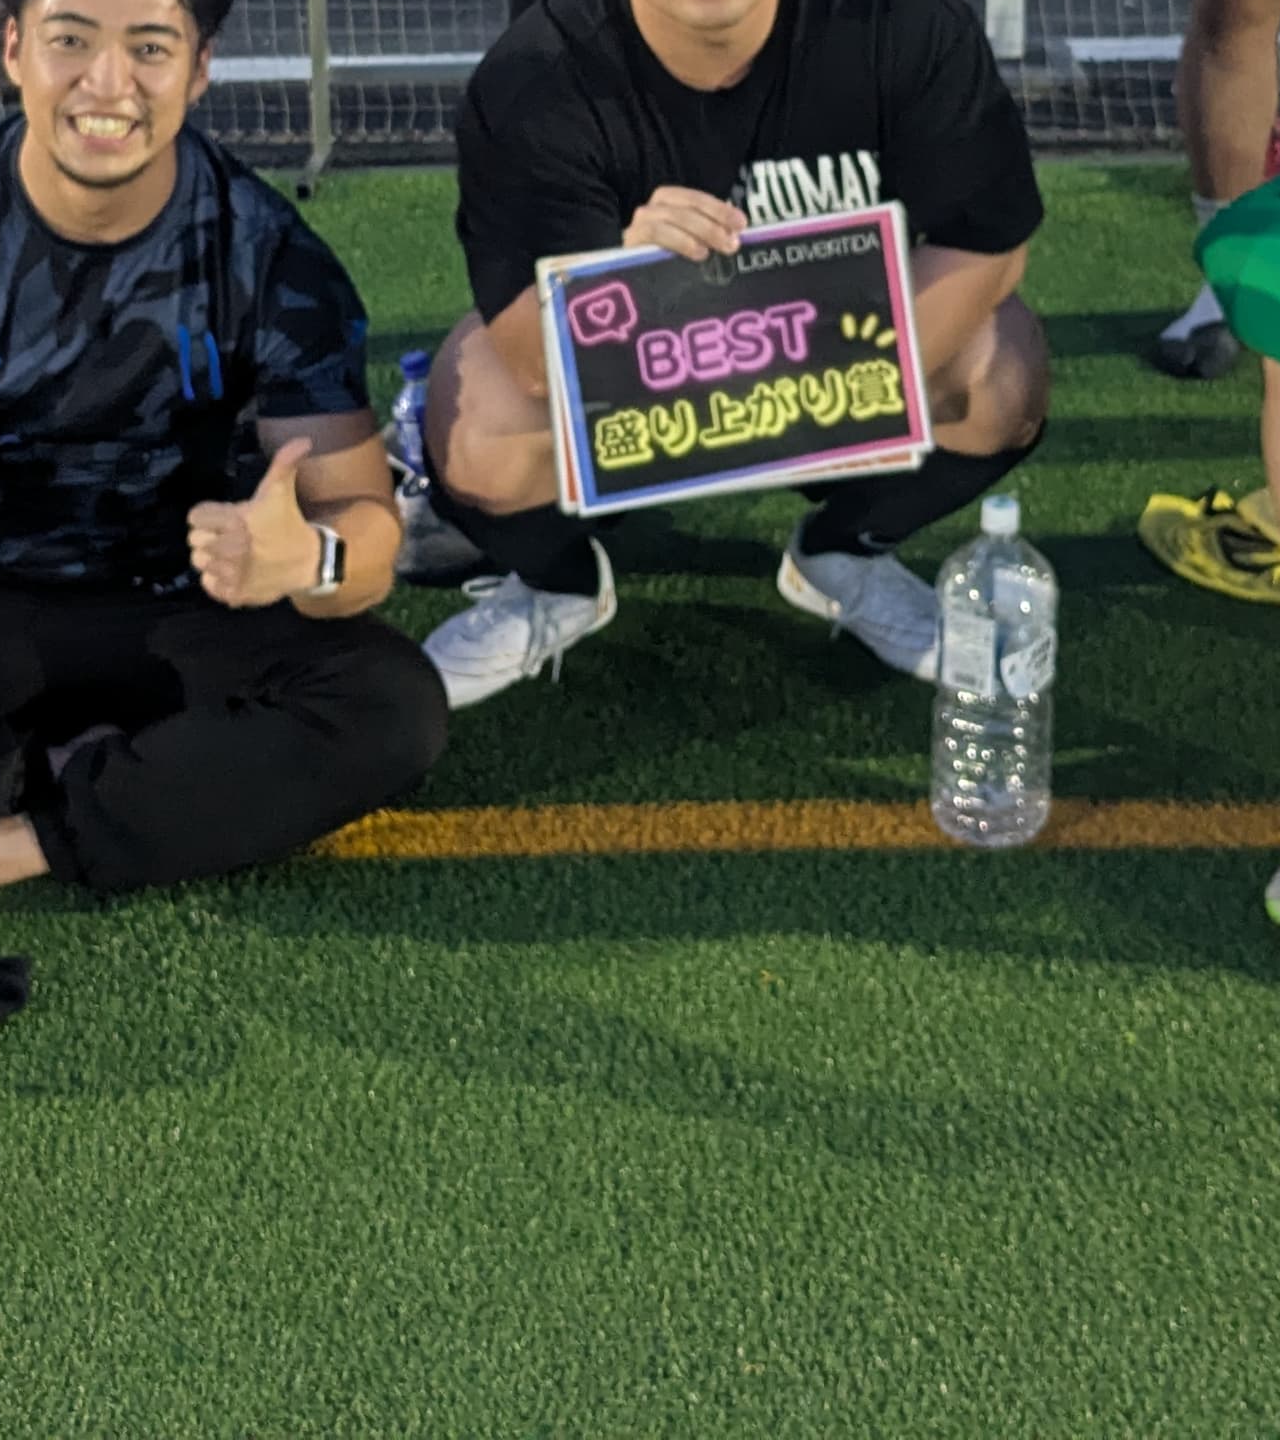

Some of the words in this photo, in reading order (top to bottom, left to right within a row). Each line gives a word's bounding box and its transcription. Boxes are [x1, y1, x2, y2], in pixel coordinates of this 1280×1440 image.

[736, 250, 783, 274] LIGA
[785, 231, 880, 265] DIVERTIDA
[637, 300, 817, 391] BEST
[595, 359, 904, 470] 盛り上がり賞
